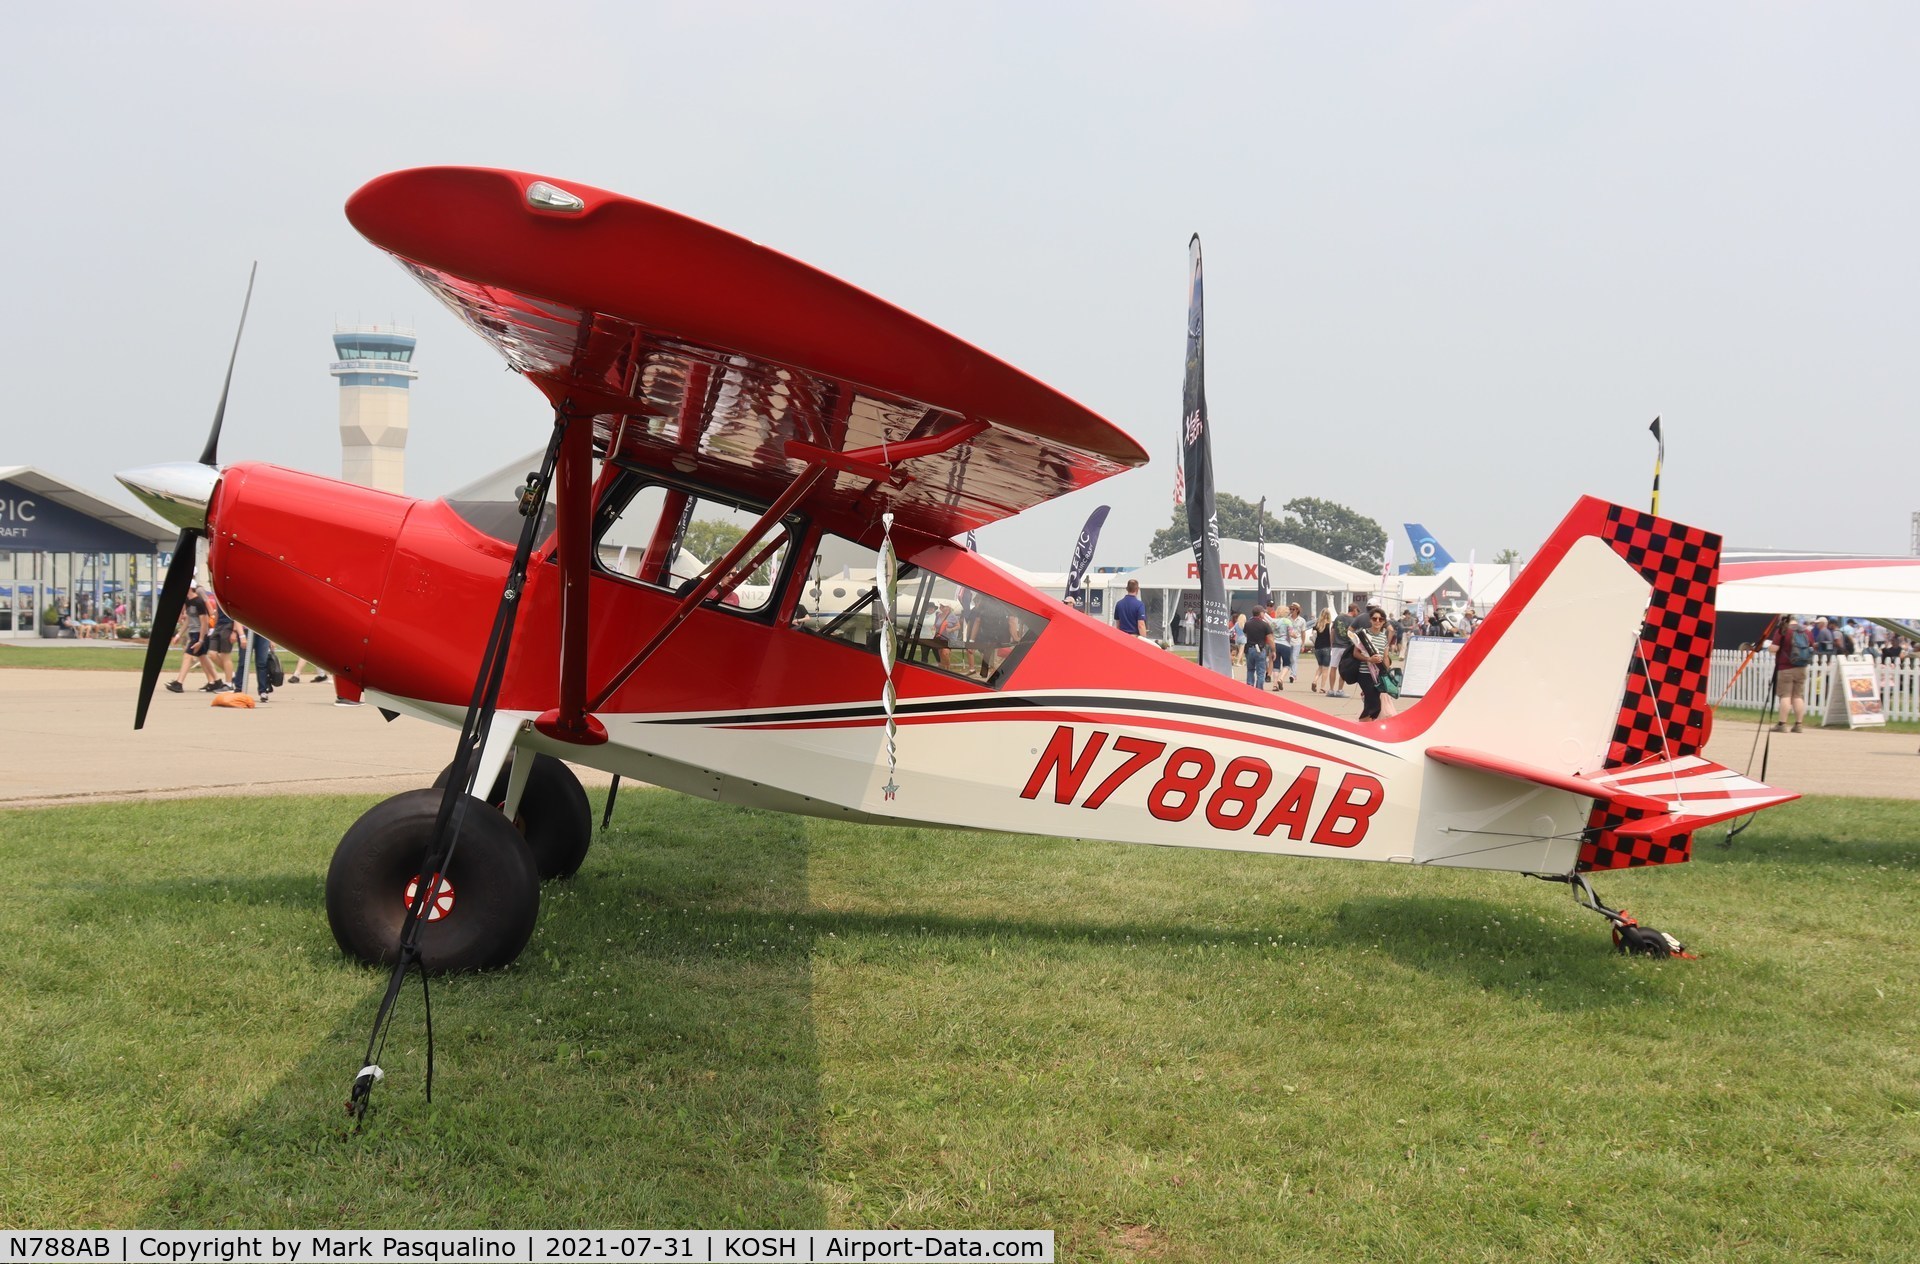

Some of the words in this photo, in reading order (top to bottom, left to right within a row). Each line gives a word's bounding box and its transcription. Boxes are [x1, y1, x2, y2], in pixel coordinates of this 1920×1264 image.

[1072, 531, 1090, 569] EPIC
[1078, 543, 1094, 573] AIRCRAFT
[1187, 563, 1258, 580] RTAX
[1019, 725, 1385, 848] N788AB
